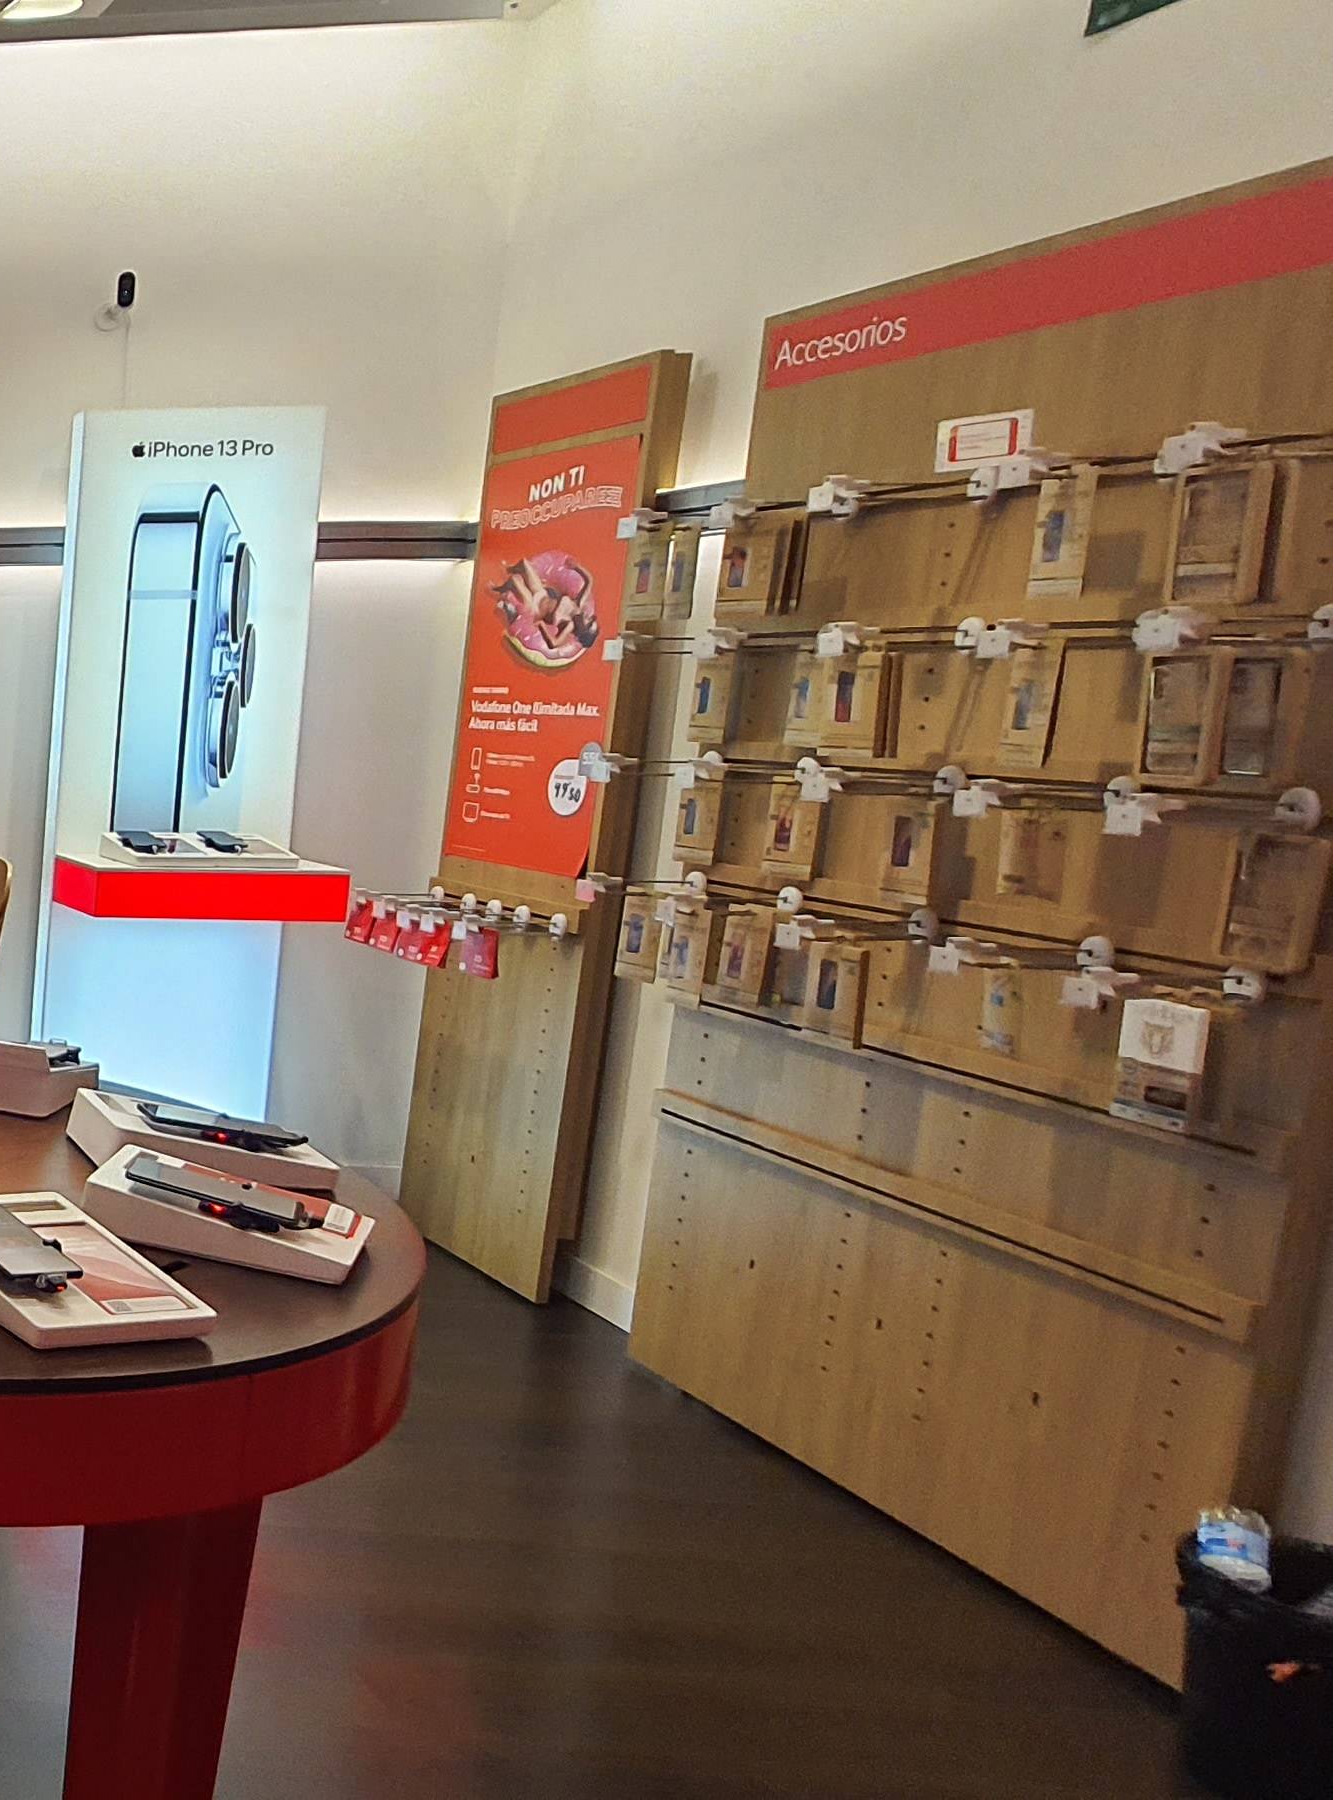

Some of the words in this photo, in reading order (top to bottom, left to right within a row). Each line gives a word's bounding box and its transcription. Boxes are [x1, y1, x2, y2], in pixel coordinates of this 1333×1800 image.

[773, 316, 908, 371] Accesorios
[147, 441, 214, 458] iPhone
[217, 439, 238, 457] 13
[241, 439, 274, 457] Pro
[528, 472, 566, 503] NON
[569, 464, 586, 488] TI
[468, 716, 495, 730] Ahora
